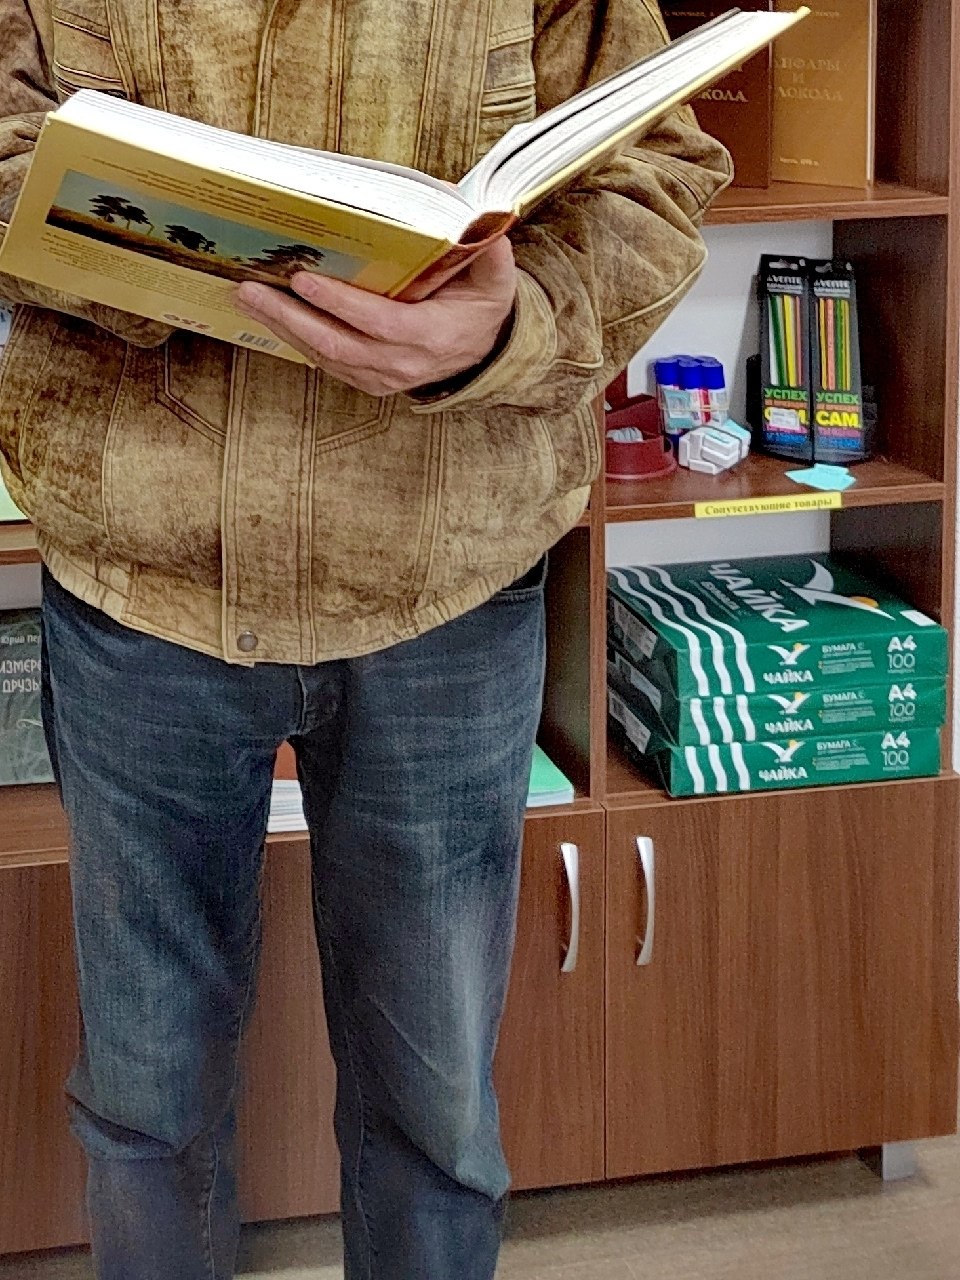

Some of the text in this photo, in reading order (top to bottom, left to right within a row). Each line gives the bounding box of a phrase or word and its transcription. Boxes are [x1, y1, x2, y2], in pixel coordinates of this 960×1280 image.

[764, 387, 808, 402] УСПЕХ
[815, 391, 860, 405] УСПЕХ
[704, 497, 833, 516] Сопутствующие товары
[0, 635, 26, 647] Юрий
[822, 643, 856, 653] БУМАГА
[888, 634, 918, 653] A4
[887, 652, 916, 669] 100
[762, 668, 814, 685] ЧАЙКА
[822, 691, 858, 703] БУМАГА
[888, 683, 918, 702] A4
[889, 702, 916, 717] 100
[764, 717, 815, 735] ЧАЙКА
[816, 739, 851, 751] БУМАГА
[881, 731, 911, 750] A4
[881, 750, 910, 766] 100
[758, 765, 808, 782] ЧАЙКА
